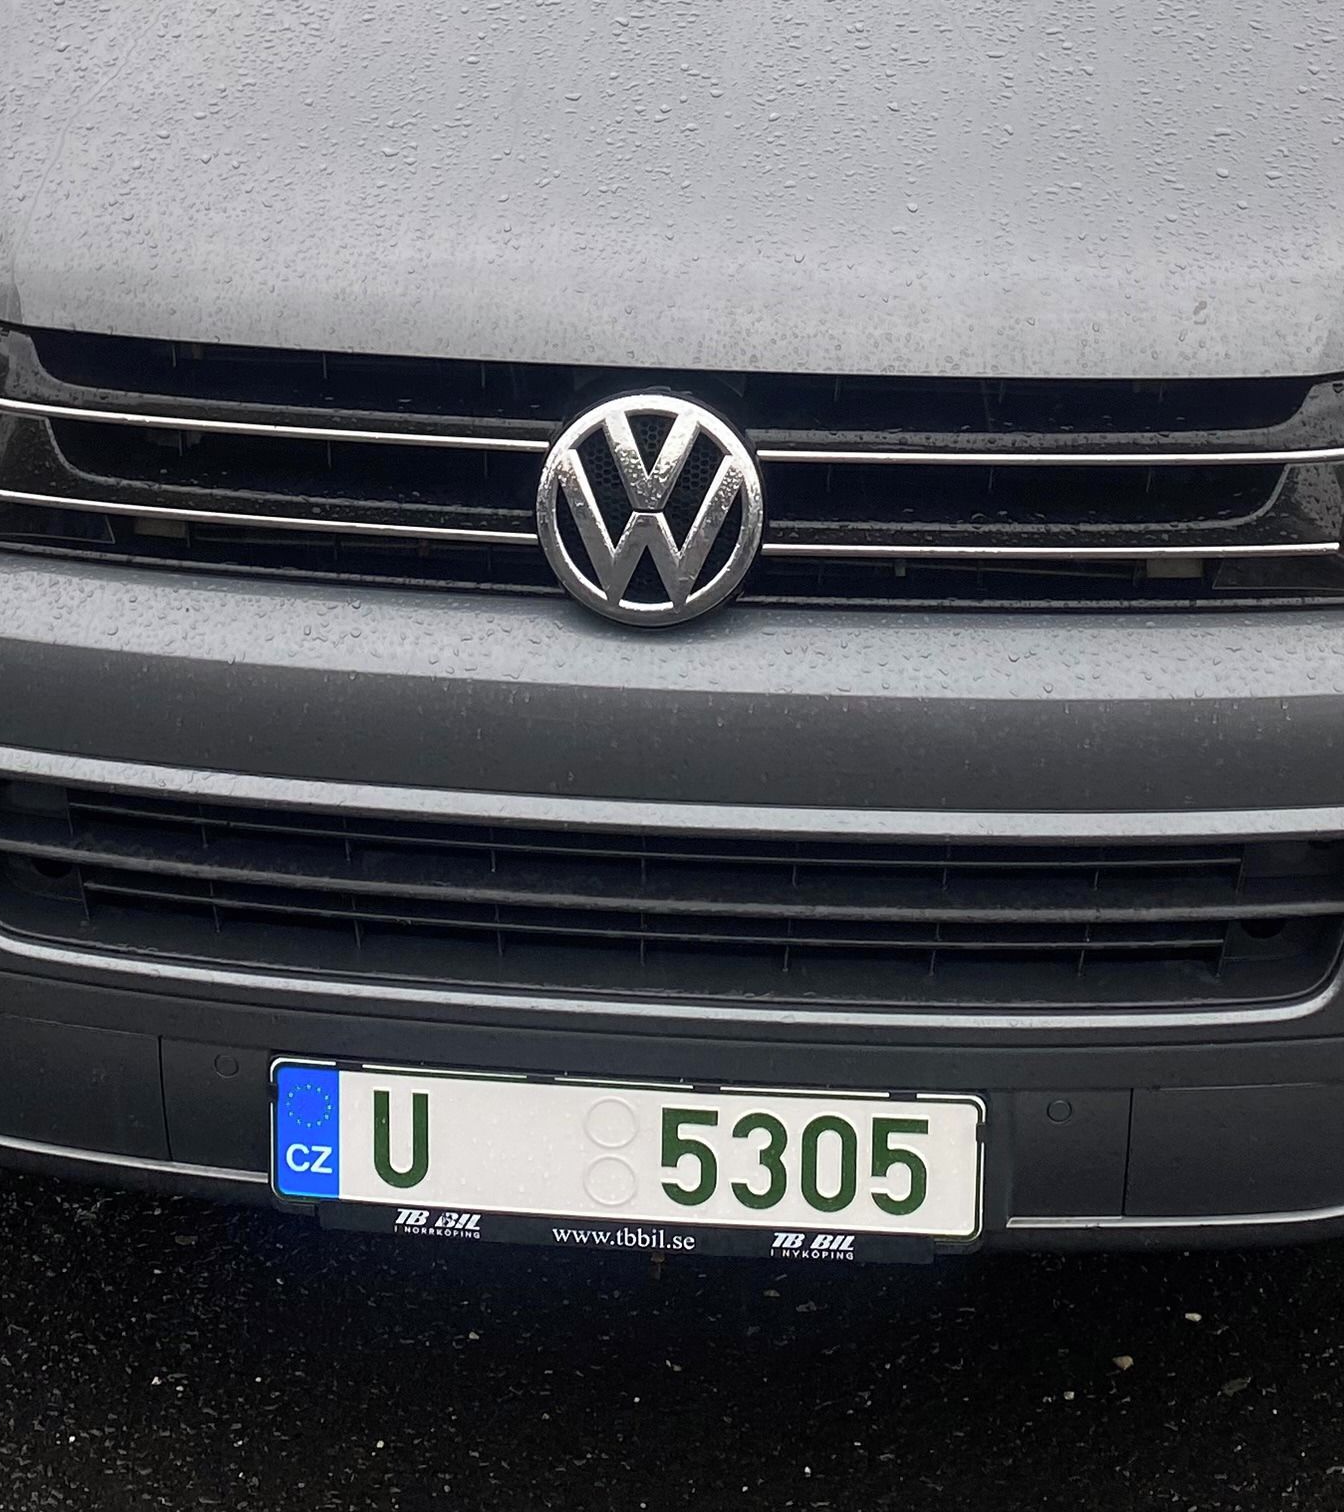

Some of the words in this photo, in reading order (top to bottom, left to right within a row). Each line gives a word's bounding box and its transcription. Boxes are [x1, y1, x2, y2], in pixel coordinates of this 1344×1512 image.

[537, 393, 764, 628] VW
[285, 1144, 333, 1175] CZ
[373, 1088, 429, 1189] U
[660, 1107, 931, 1216] 5305
[396, 1208, 430, 1225] TB
[435, 1212, 481, 1230] BIL
[552, 1228, 696, 1250] www.tbbil.se
[772, 1232, 805, 1248] TB
[810, 1234, 855, 1250] BIL
